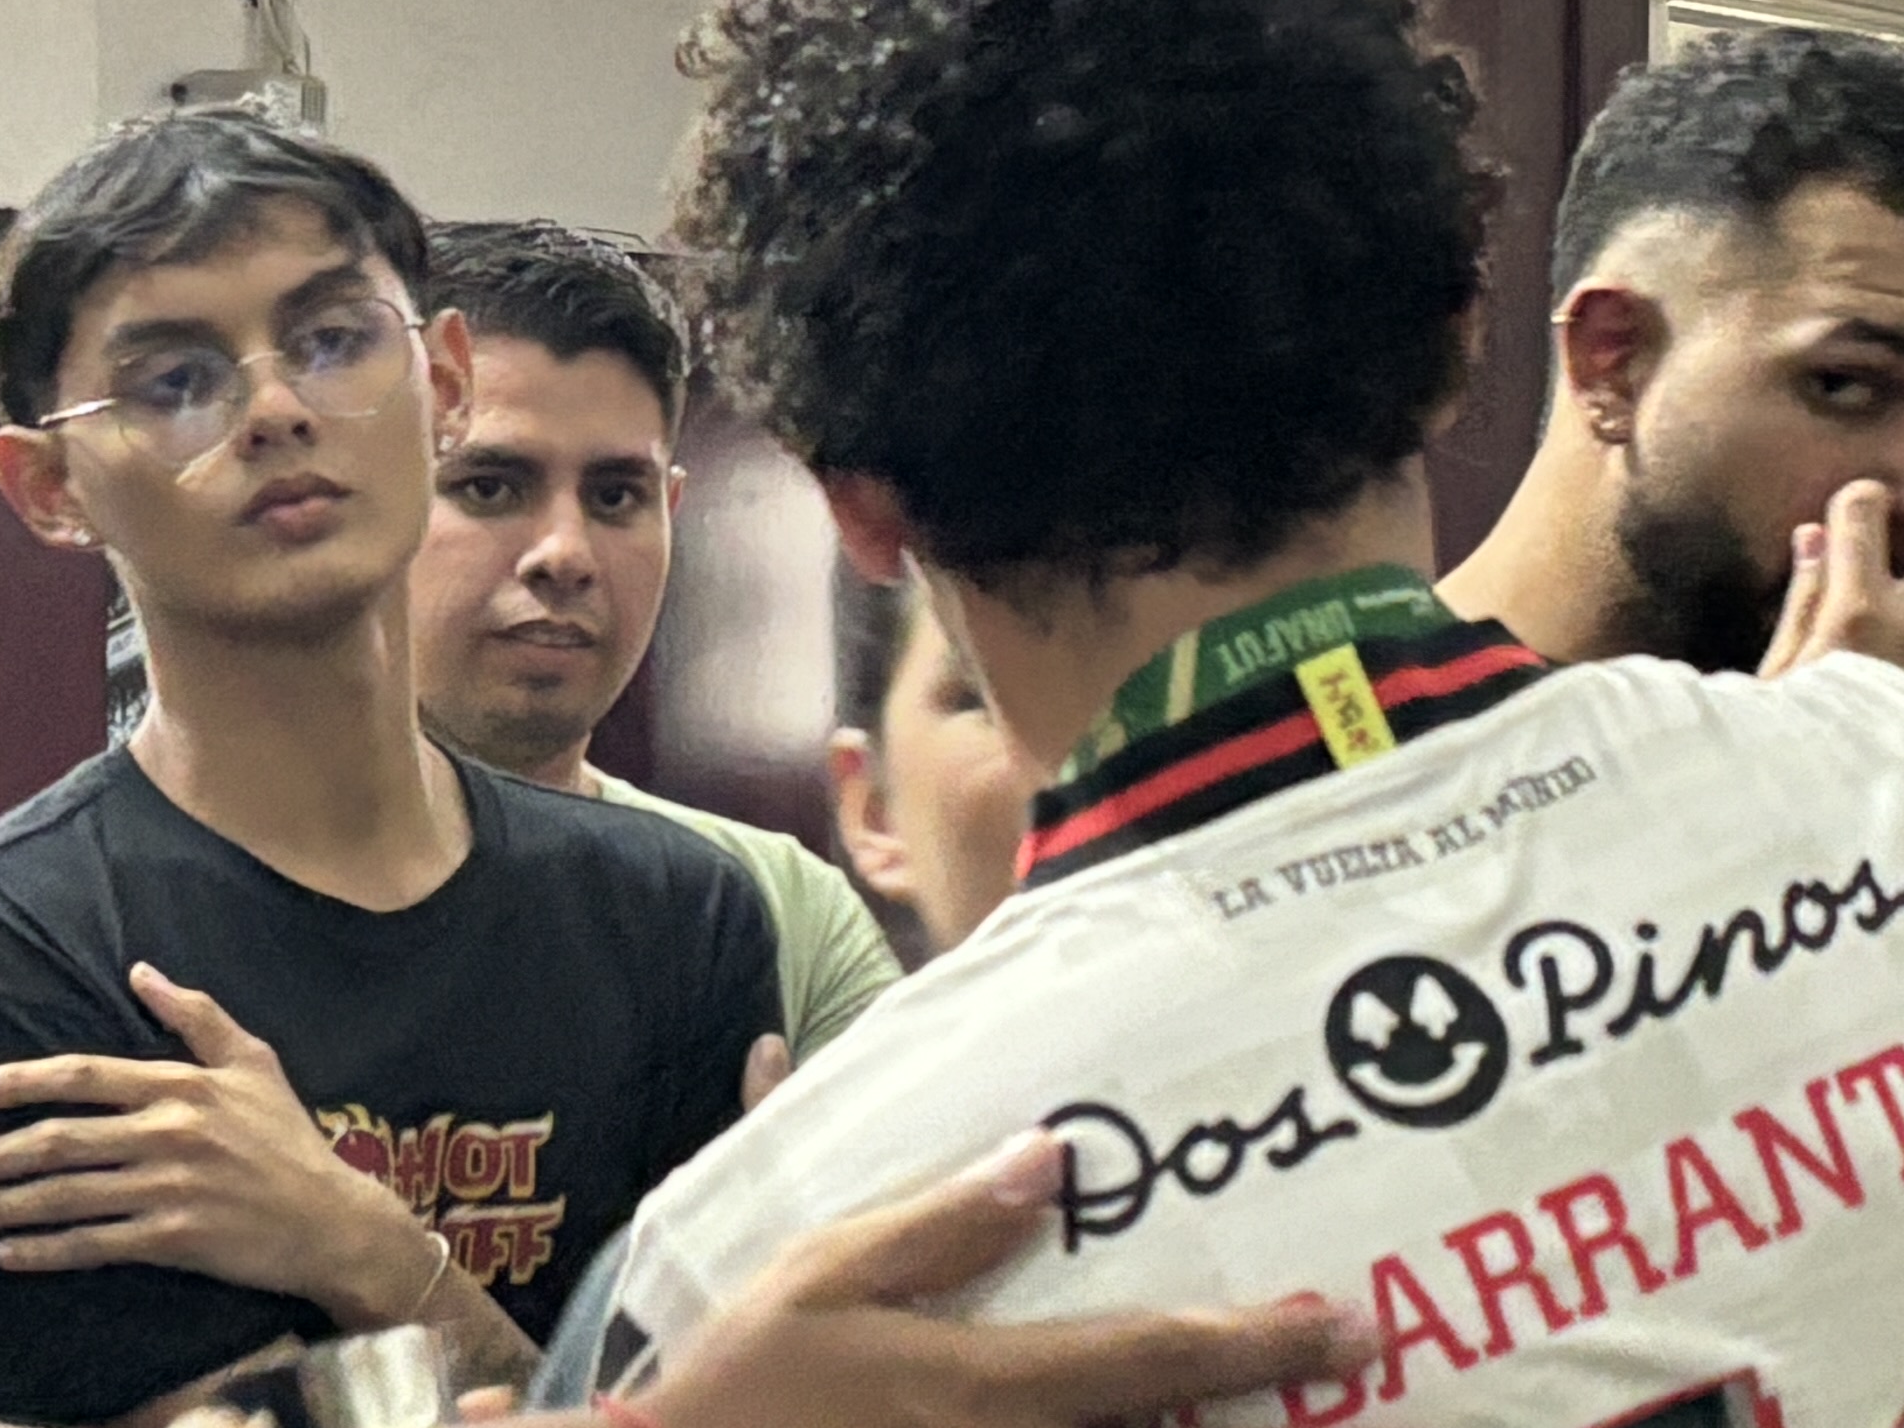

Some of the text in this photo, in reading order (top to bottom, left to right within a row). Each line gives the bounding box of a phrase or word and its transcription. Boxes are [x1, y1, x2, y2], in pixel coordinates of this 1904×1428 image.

[1211, 876, 1274, 920] LA
[1276, 831, 1425, 896] VUELTA
[1427, 813, 1487, 860] AL
[393, 1110, 555, 1207] HOT
[1042, 1085, 1359, 1255] Dos
